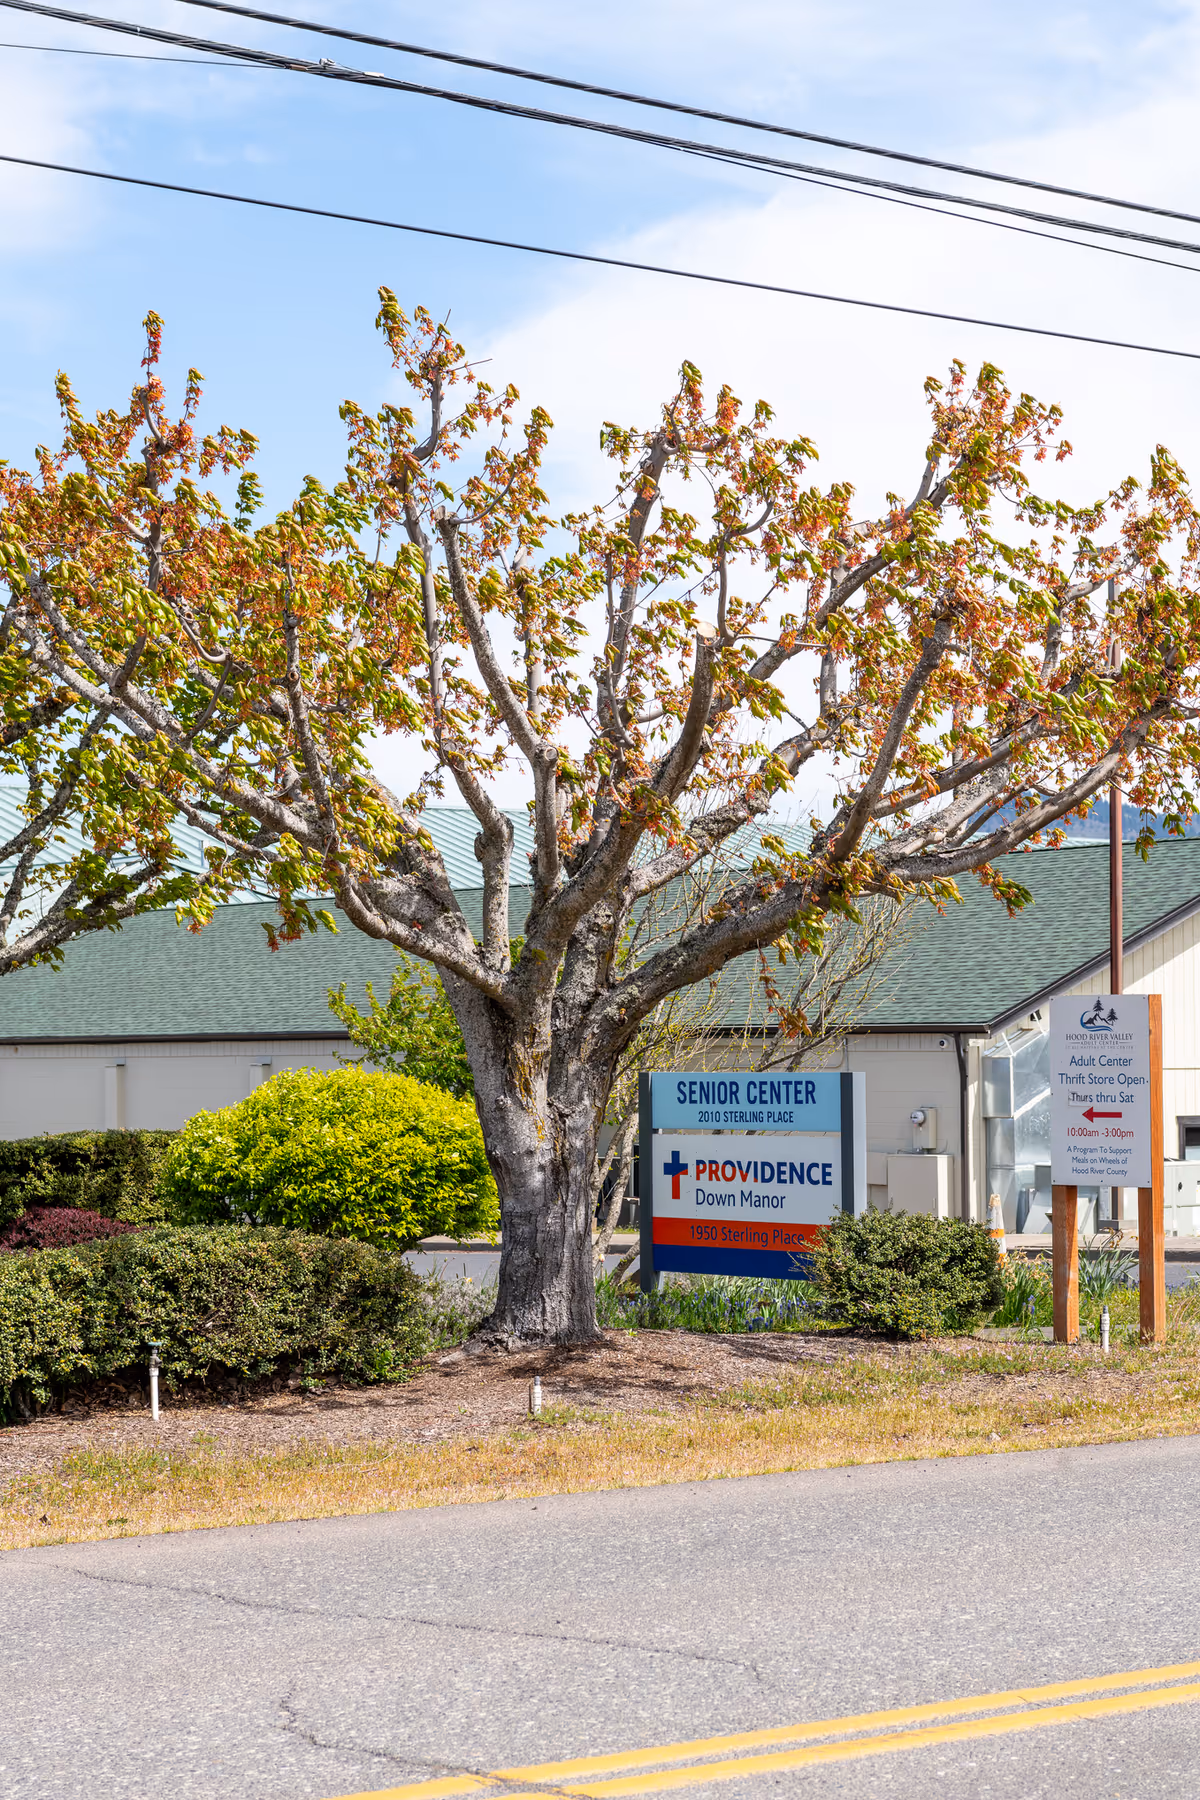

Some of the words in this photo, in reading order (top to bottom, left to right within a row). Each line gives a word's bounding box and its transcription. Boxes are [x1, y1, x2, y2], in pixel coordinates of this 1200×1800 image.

[1069, 1055, 1096, 1066] Adult
[1098, 1055, 1133, 1066] Center
[1058, 1072, 1086, 1085] Thrift
[1088, 1072, 1115, 1085] Store
[1117, 1073, 1145, 1088] Open
[676, 1080, 740, 1105] SENIOR
[746, 1080, 817, 1105] CENTER
[1071, 1092, 1093, 1103] Thurs
[1095, 1091, 1117, 1103] thru
[1119, 1091, 1135, 1103] Sat
[698, 1111, 721, 1123] 2010
[723, 1111, 764, 1123] STERLING
[766, 1111, 794, 1123] PLACE
[1067, 1127, 1100, 1137] 10:00am
[1101, 1127, 1135, 1140] -3:00pm
[1066, 1145, 1072, 1153] A
[1073, 1145, 1098, 1155] Program
[1108, 1146, 1132, 1155] Support
[1071, 1156, 1089, 1164] Meals
[1098, 1156, 1120, 1164] Wheels
[1121, 1157, 1128, 1165] of
[695, 1159, 833, 1186] PROVIDENCE
[1071, 1166, 1089, 1175] Hood
[1089, 1167, 1105, 1175] River
[1106, 1167, 1128, 1177] County
[696, 1188, 736, 1207] Down
[740, 1189, 786, 1209] Manor
[689, 1225, 718, 1241] 1950
[721, 1226, 769, 1248] Sterling
[773, 1228, 805, 1246] Place
